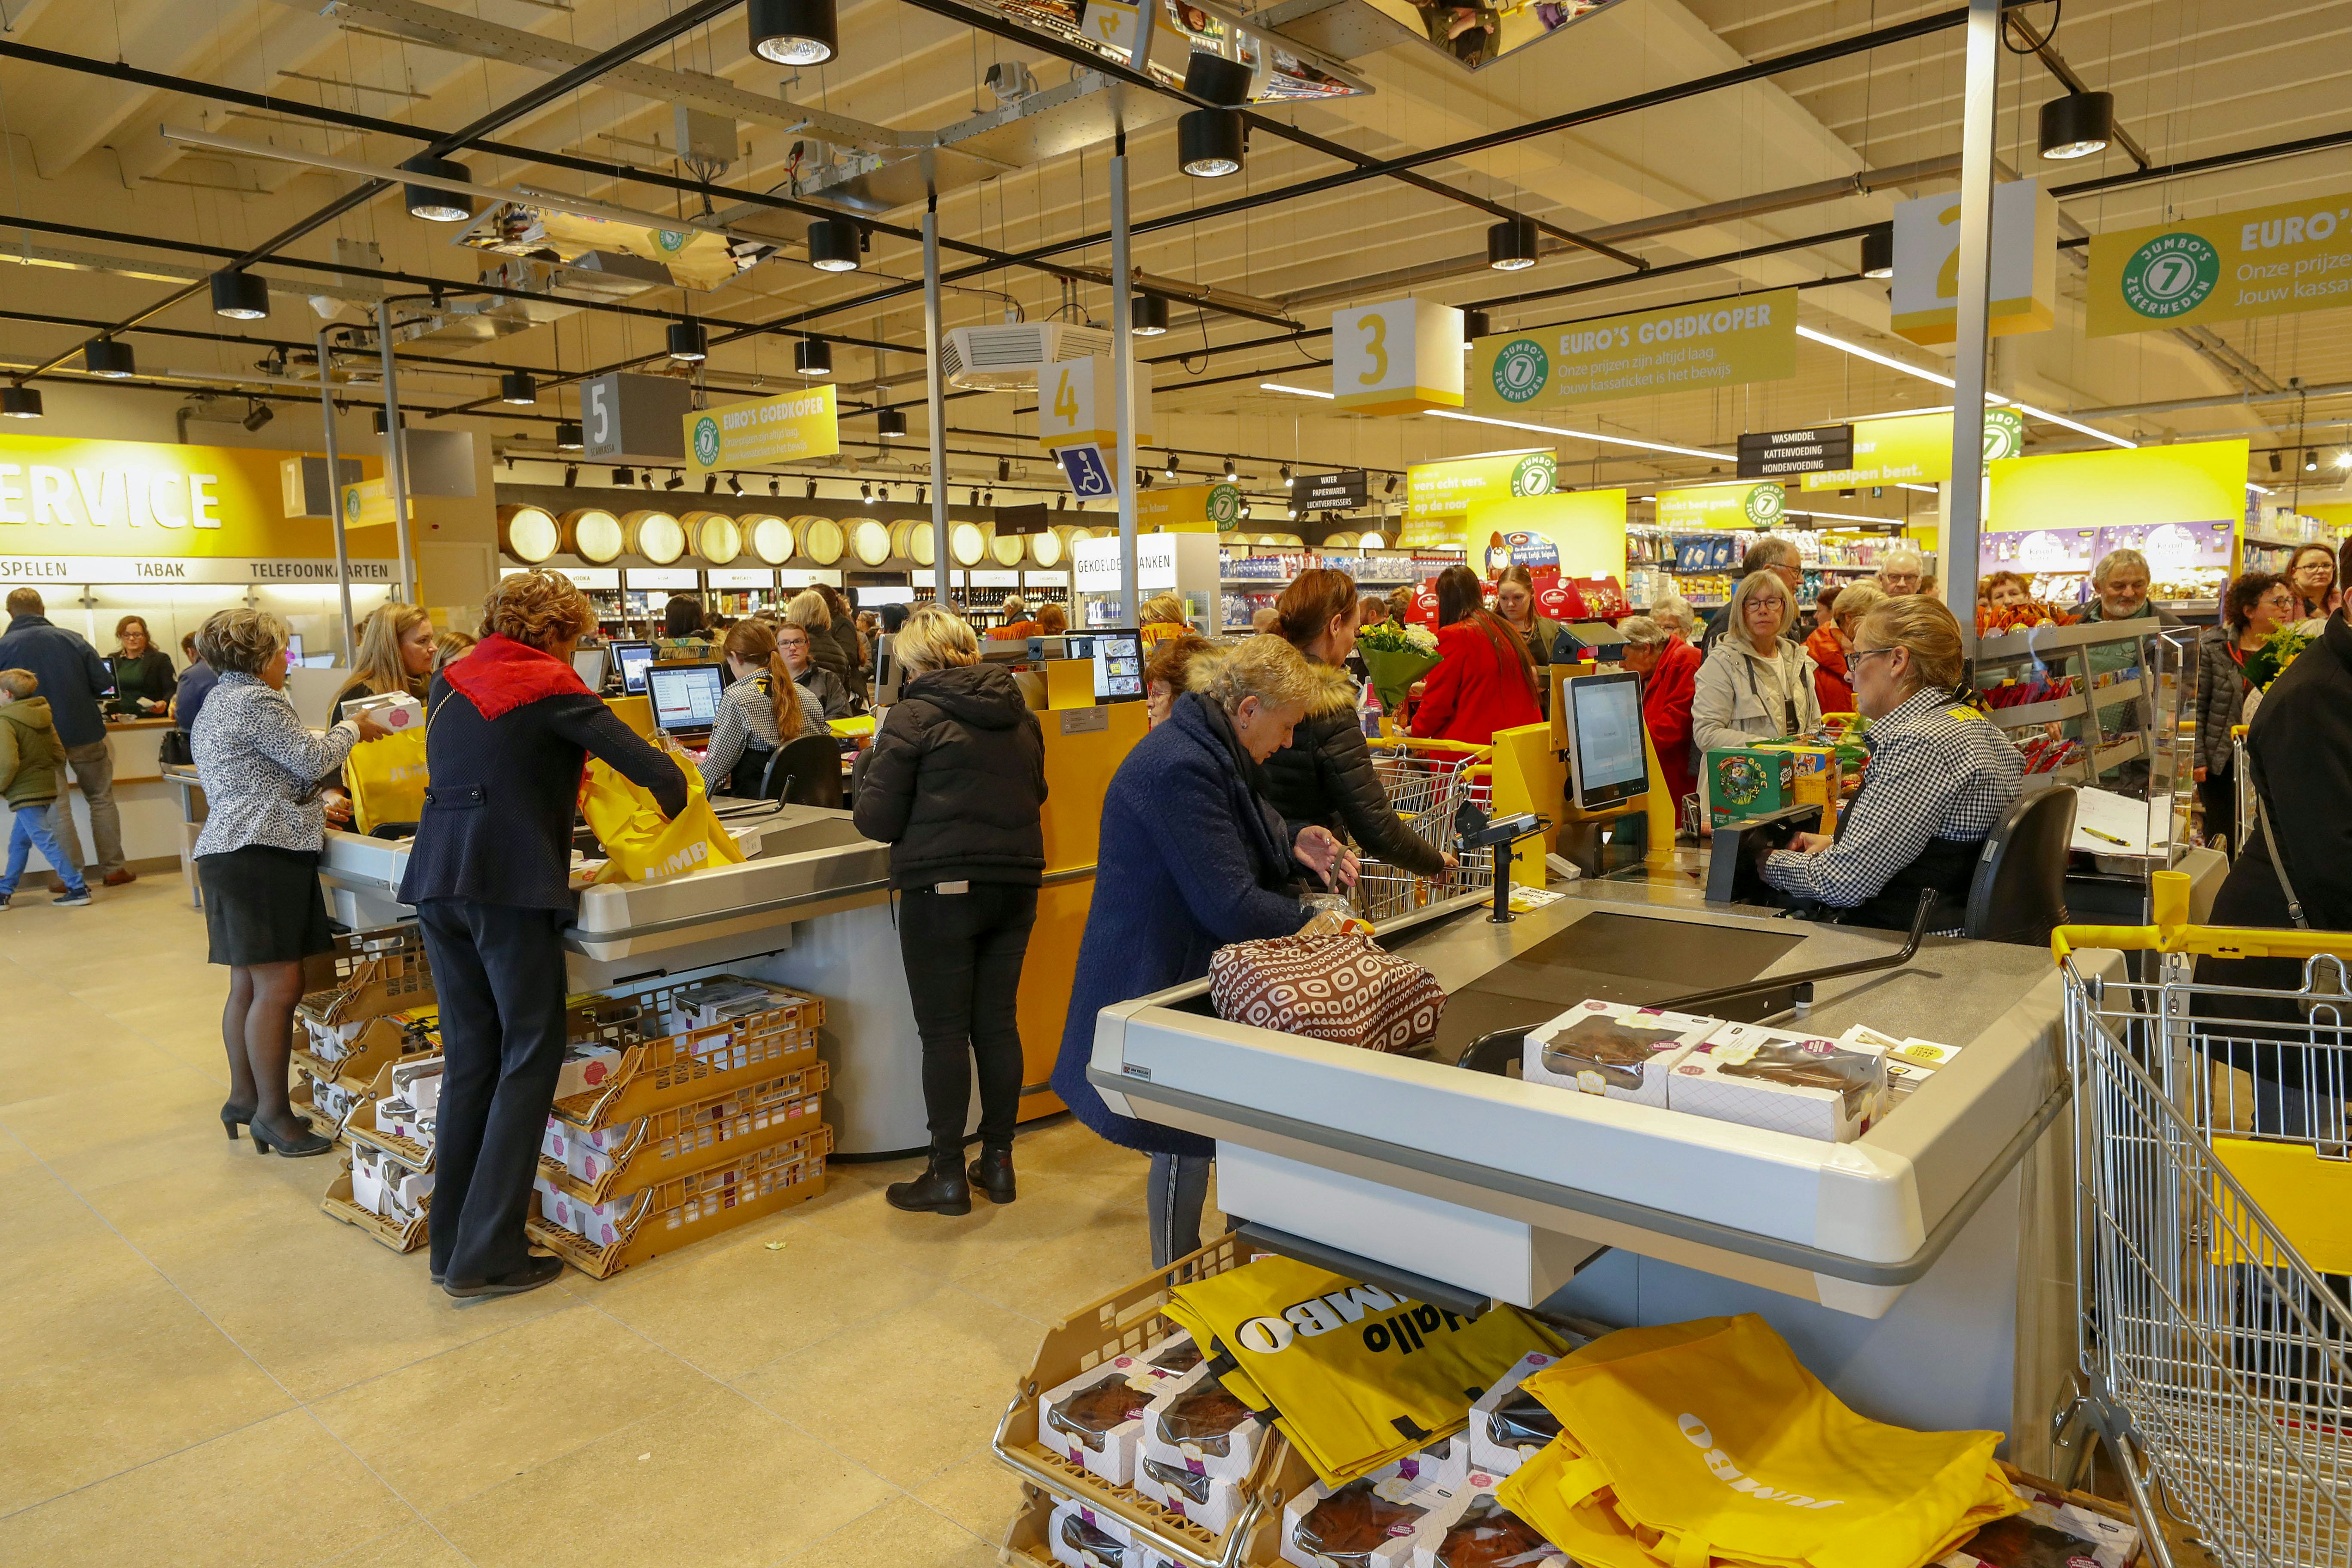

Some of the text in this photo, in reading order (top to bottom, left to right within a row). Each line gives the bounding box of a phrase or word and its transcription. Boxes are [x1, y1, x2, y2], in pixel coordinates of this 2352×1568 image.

[2241, 208, 2352, 251] EURO'
[2141, 238, 2211, 261] JUMBO'S
[2160, 262, 2183, 291] 7
[2237, 261, 2290, 281] Onze
[2126, 276, 2210, 315] ZEKERHEDEN
[2235, 288, 2288, 306] Jouw
[1560, 304, 1771, 355] EURO'S GOEDKOPER
[1358, 314, 1387, 385] 3
[1503, 343, 1544, 361] JUMBO'S
[1515, 361, 1527, 382] 7
[1559, 347, 1717, 377] Onze prijzen zijn altijd laag.
[1495, 371, 1544, 400] ZEKERHEDEN
[1558, 363, 1731, 396] Jouw kassaticket is het bewijs
[1054, 368, 1078, 426] 4
[592, 384, 608, 444] 5
[723, 396, 824, 430] EURO'S GOEDKOPER
[698, 419, 717, 435] JUMBO'S
[1986, 413, 2021, 434] MBO'S
[704, 434, 710, 450] 7
[725, 428, 799, 447] Onze prijzen zijn altijd laag.
[1772, 432, 1815, 444] WASMIDDEL
[1984, 434, 2000, 455] 7
[591, 444, 615, 456] SCANKASSA
[695, 441, 718, 463] ZEKERHEDEN
[726, 451, 739, 461] Jouw
[740, 447, 770, 459] kassaticket
[777, 444, 786, 453] het
[787, 441, 807, 452] bewijs
[1764, 445, 1822, 459] KATTENVOEDING
[1522, 456, 1556, 473] JUMBO'S
[1763, 460, 1823, 473] HONDENVOEDING
[1321, 476, 1337, 484] WATER
[1414, 477, 1485, 491] vers echt vers.
[1529, 472, 1543, 491] 7
[1810, 464, 1923, 487] geholpen bent.
[0, 463, 222, 529] ERVICE
[1214, 487, 1238, 501] JUMBO'S
[1313, 487, 1345, 496] PAPIERWAREN
[1755, 486, 1784, 499] JUMBO'S
[1220, 500, 1229, 516] 7
[1307, 498, 1351, 508] LUCHTVERFRISSERS
[1415, 499, 1470, 514] op de roos
[1761, 498, 1772, 511] 7
[1747, 503, 1783, 524] ZEKERHEDEN
[1, 562, 67, 576] SPELEN
[135, 563, 185, 577] TABAK
[1078, 555, 1170, 573] GEKOELDE ANKEN
[1678, 1413, 1844, 1509] JUMBO
